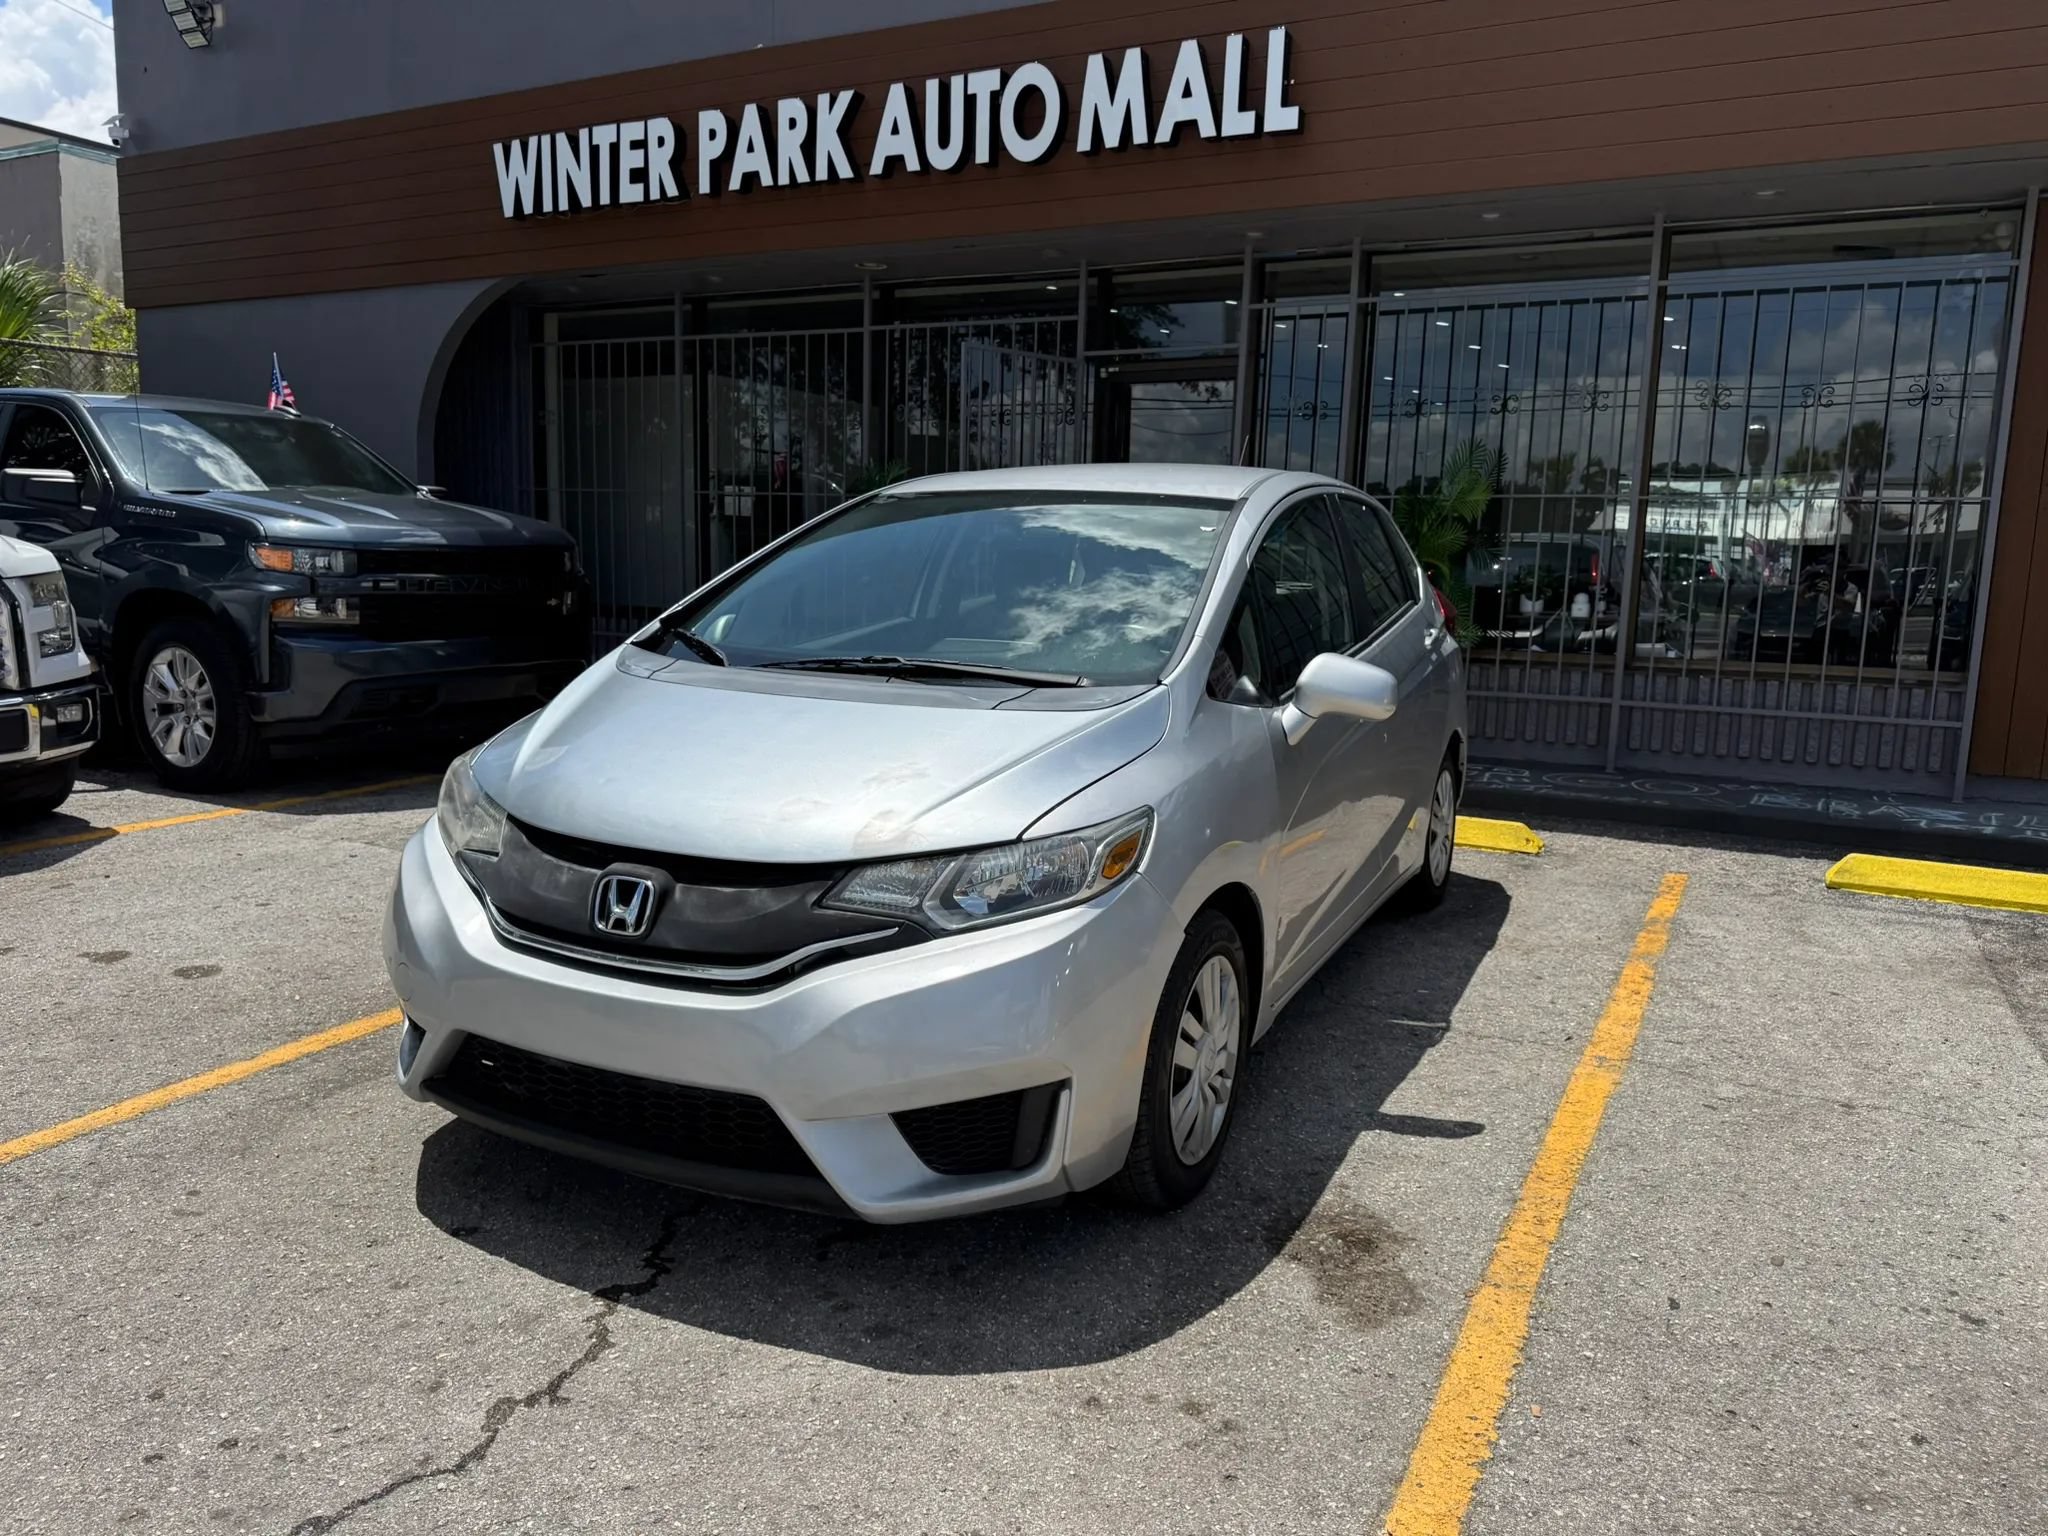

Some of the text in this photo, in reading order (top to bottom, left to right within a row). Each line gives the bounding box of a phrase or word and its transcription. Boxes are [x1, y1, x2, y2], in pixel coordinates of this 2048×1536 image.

[493, 28, 1299, 218] WINTER PARK AUTO MALL
